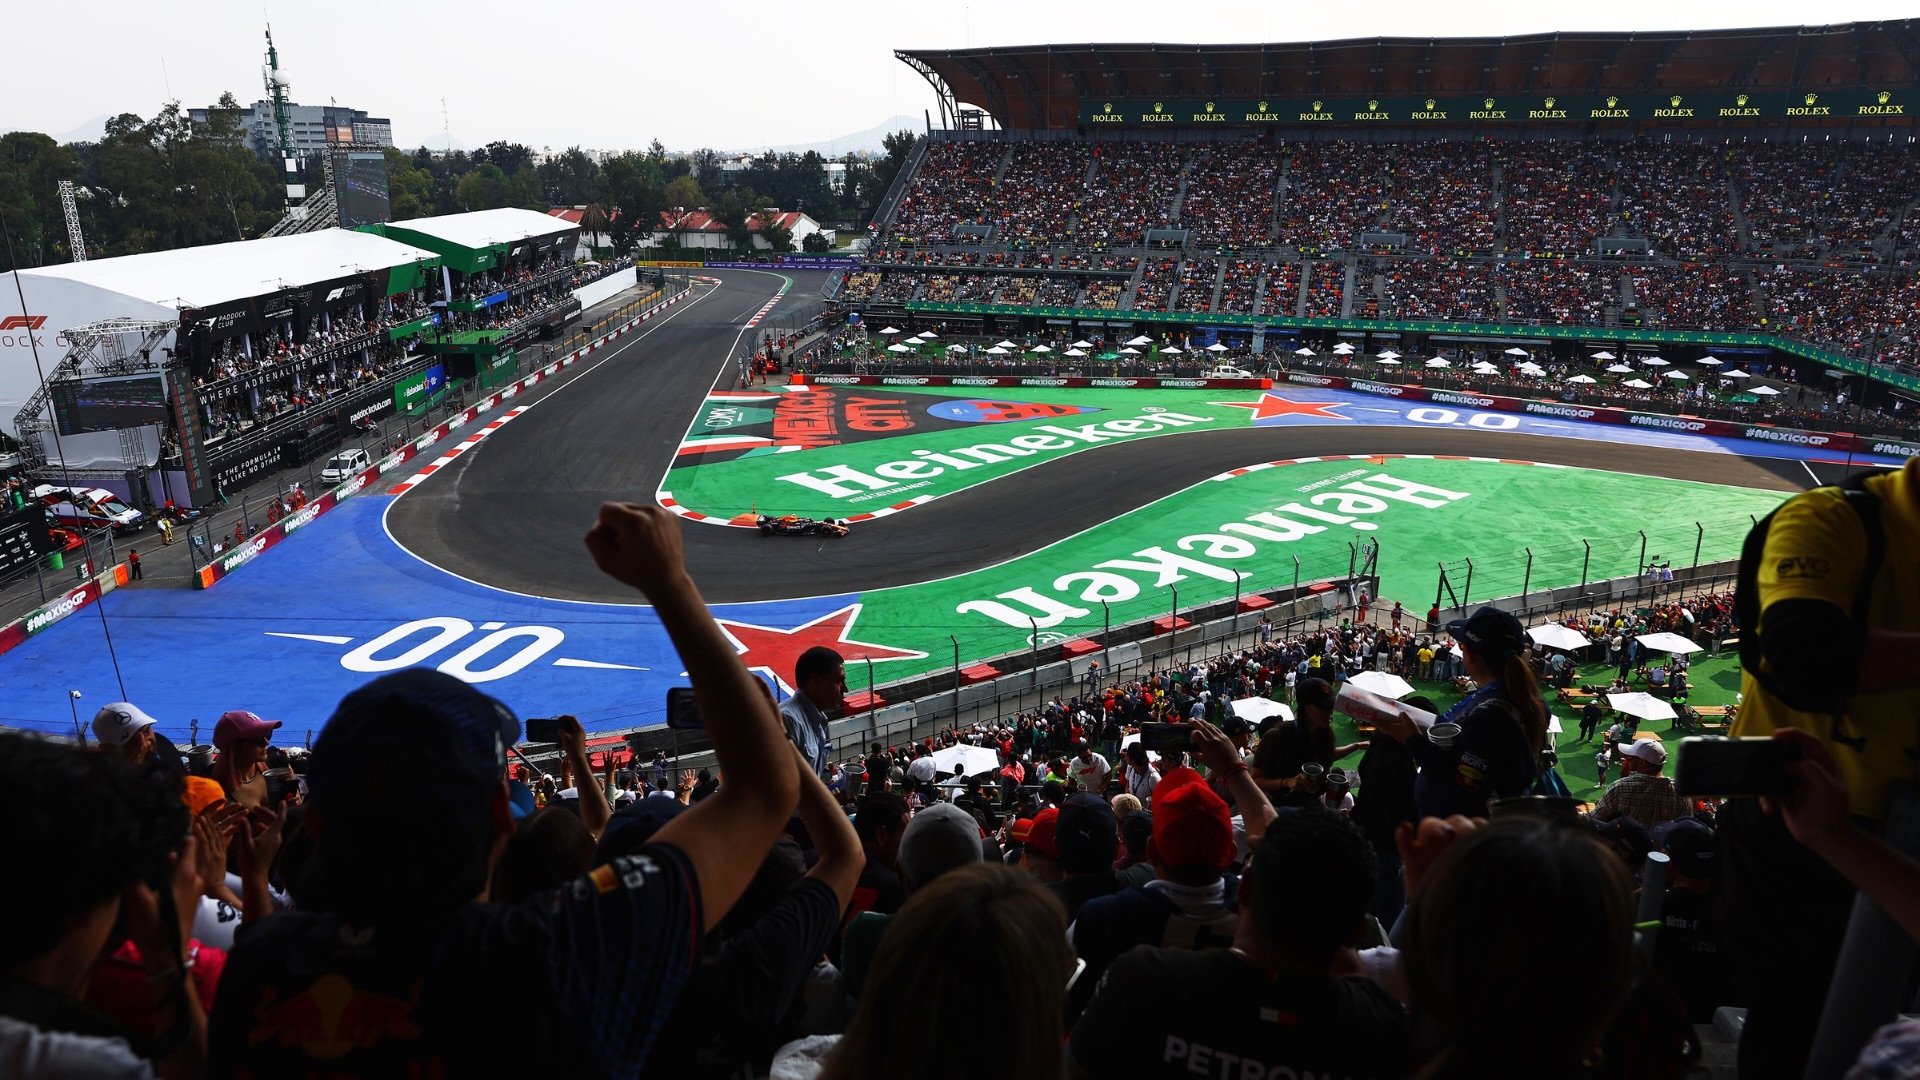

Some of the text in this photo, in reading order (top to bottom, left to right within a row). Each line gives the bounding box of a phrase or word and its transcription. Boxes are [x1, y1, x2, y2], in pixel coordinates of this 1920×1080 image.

[1193, 114, 1226, 122] ROLEX
[1299, 113, 1333, 121] ROLEX
[1411, 112, 1447, 120] ROLEX
[1469, 111, 1506, 119] ROLEX
[1529, 110, 1567, 118] ROLEX
[1590, 109, 1630, 118] ROLEX
[1653, 109, 1694, 117] ROLEX
[1719, 108, 1760, 116] ROLEX
[1786, 107, 1830, 116] ROLEX
[1858, 105, 1904, 115] ROLEX
[217, 320, 234, 329] CLUB
[218, 310, 246, 322] PADDOCK
[199, 336, 382, 405] WHERE ADRENALINE MEETS ELEGANCE
[883, 377, 929, 385] #MexicoGP
[1021, 378, 1067, 386] #MexicoGP
[1289, 374, 1332, 385] #MexicoGP
[1351, 381, 1403, 395] #MexicoGP
[1432, 392, 1494, 407] #MexicoGP
[350, 398, 392, 423] paddockclub.com
[1526, 403, 1594, 418] #MexicoGP
[1630, 415, 1706, 431] #MexicoGP
[1746, 428, 1829, 445] #MexicoGP
[225, 466, 239, 477] THE
[241, 454, 269, 472] FORMULA
[231, 471, 247, 482] LIKE
[260, 455, 281, 469] OTHER
[336, 475, 366, 500] #MexicoGP
[285, 503, 321, 533] #MexicoGP
[224, 537, 266, 571] #MexicoGP
[26, 590, 87, 632] #MexicoGP
